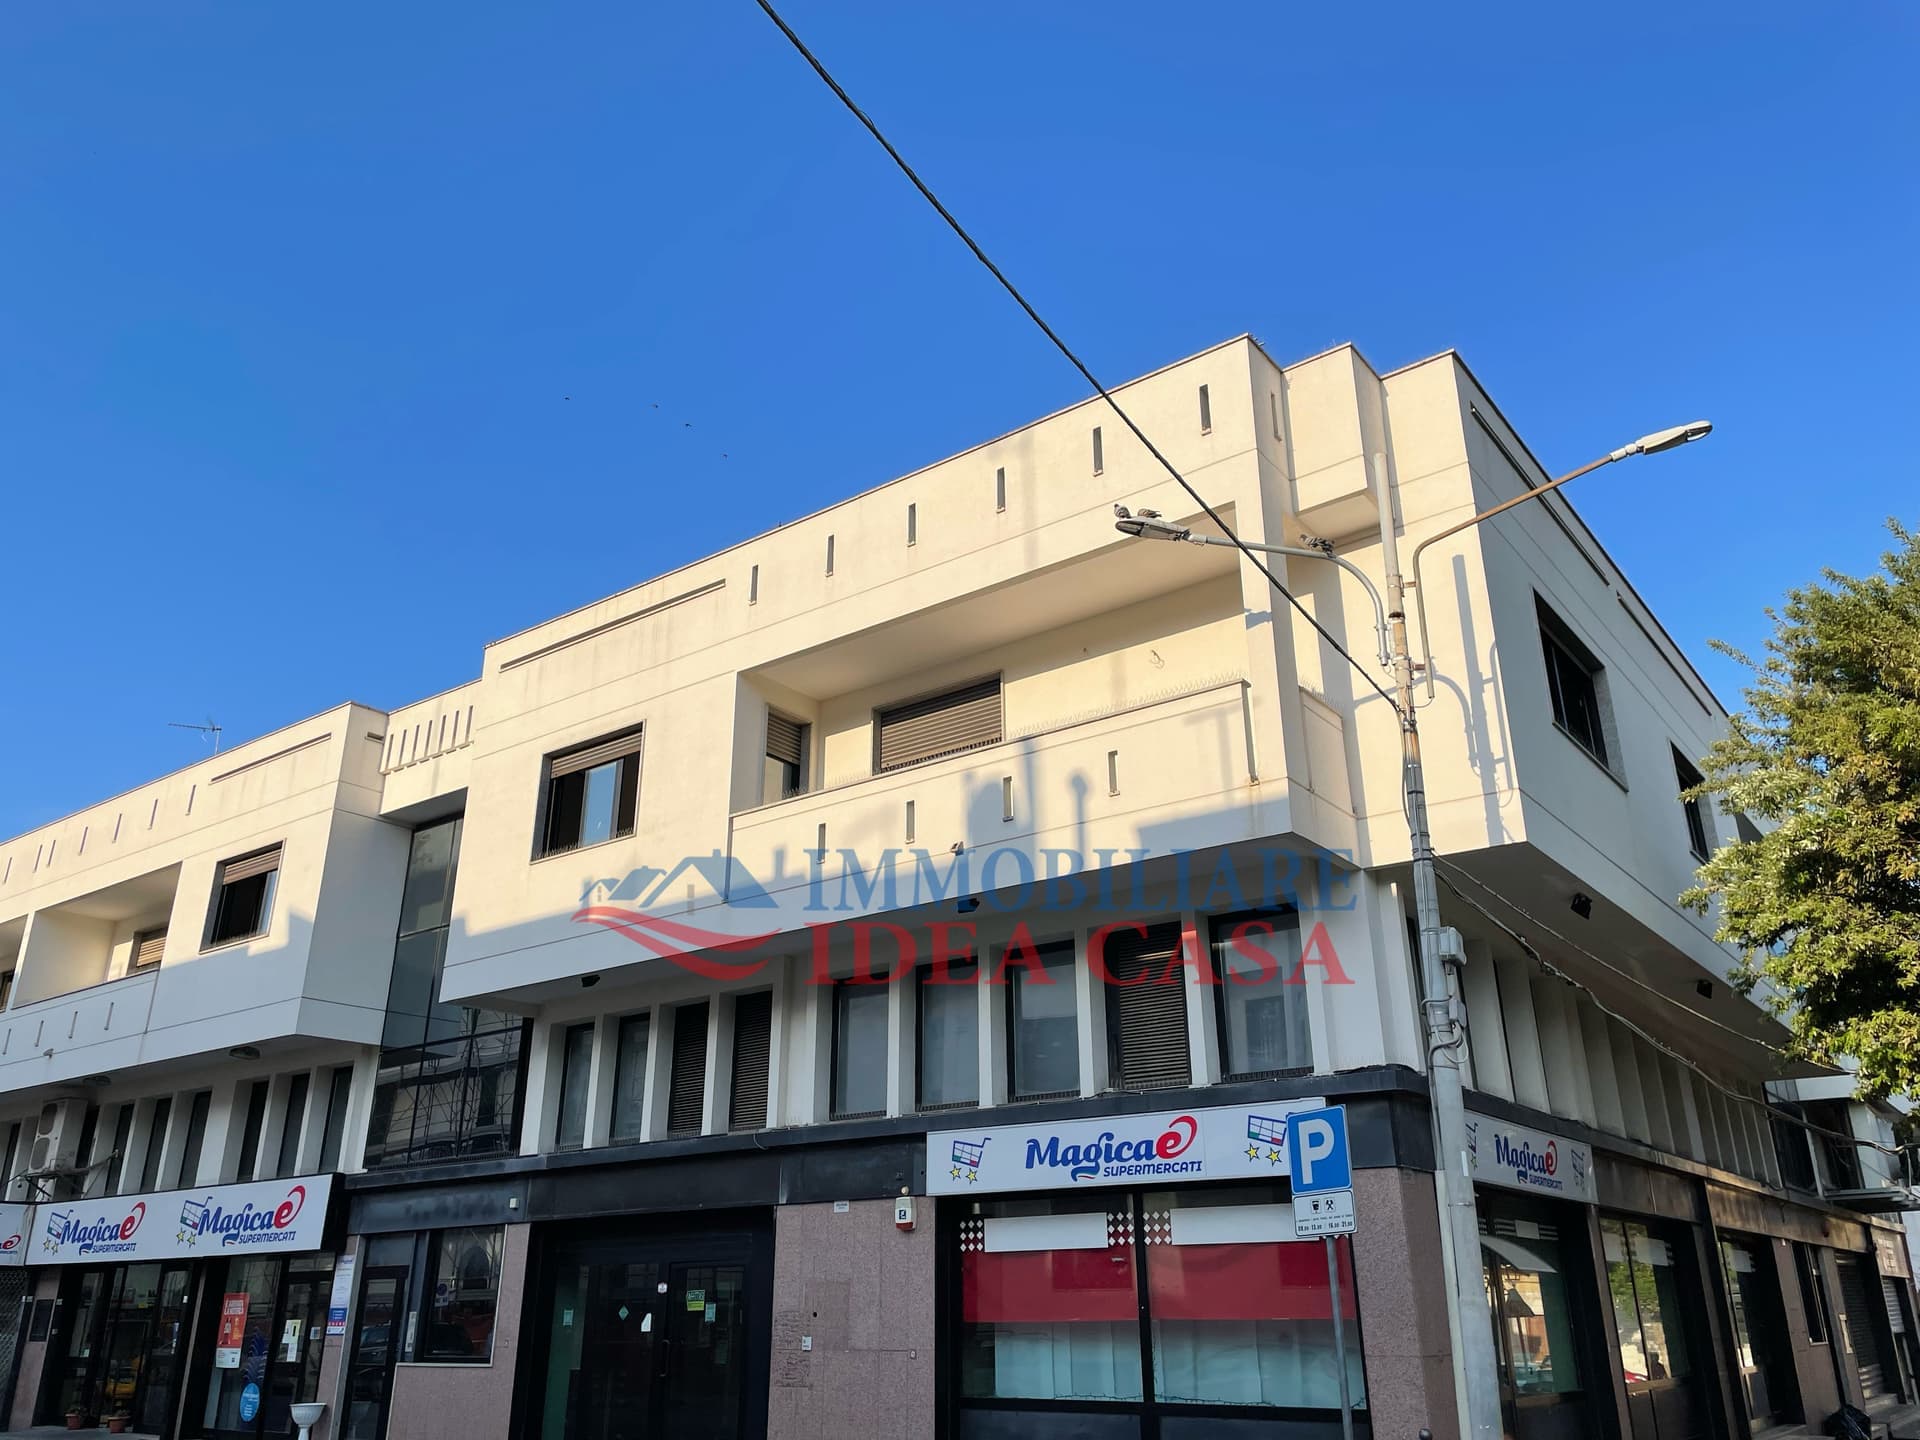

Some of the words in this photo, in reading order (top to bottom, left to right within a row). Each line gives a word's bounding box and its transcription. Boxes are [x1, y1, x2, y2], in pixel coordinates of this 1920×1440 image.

[1298, 1118, 1335, 1185] P
[1103, 1160, 1203, 1177] SUPERMERCATI
[238, 1230, 297, 1244] SUPERMERCATI
[91, 1242, 137, 1254] SUPERMERCATI
